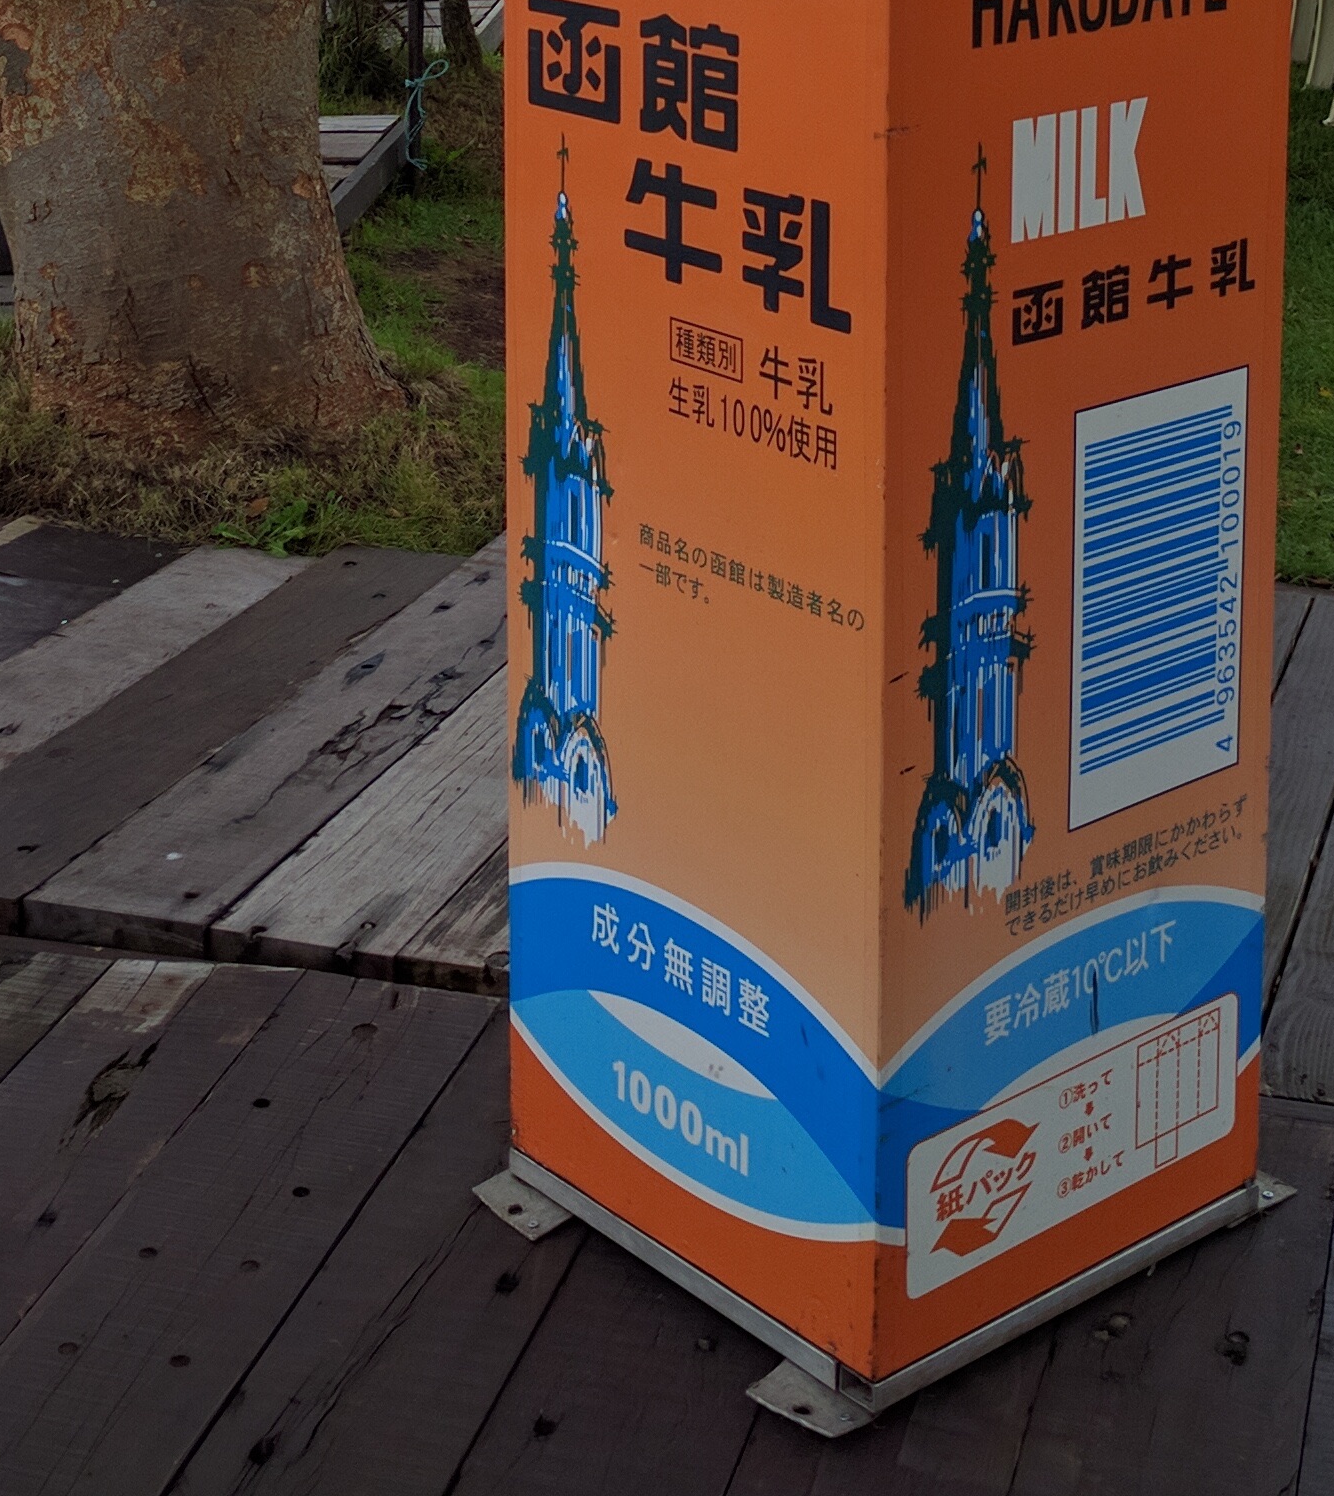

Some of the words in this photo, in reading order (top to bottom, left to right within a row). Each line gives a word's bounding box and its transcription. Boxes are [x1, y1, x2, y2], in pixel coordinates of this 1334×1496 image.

[1010, 96, 1149, 245] MILK
[623, 157, 852, 335] 牛乳
[1011, 237, 1256, 347] 函館牛乳
[667, 376, 838, 471] 生乳100%使用
[674, 325, 738, 375] 種類別
[758, 345, 833, 416] 牛乳
[638, 522, 866, 632] 商品名の函館は製造者名の
[591, 902, 771, 1038] 成分無調整
[612, 1059, 750, 1178] 1000ml
[935, 1150, 1039, 1223] 紙パック
